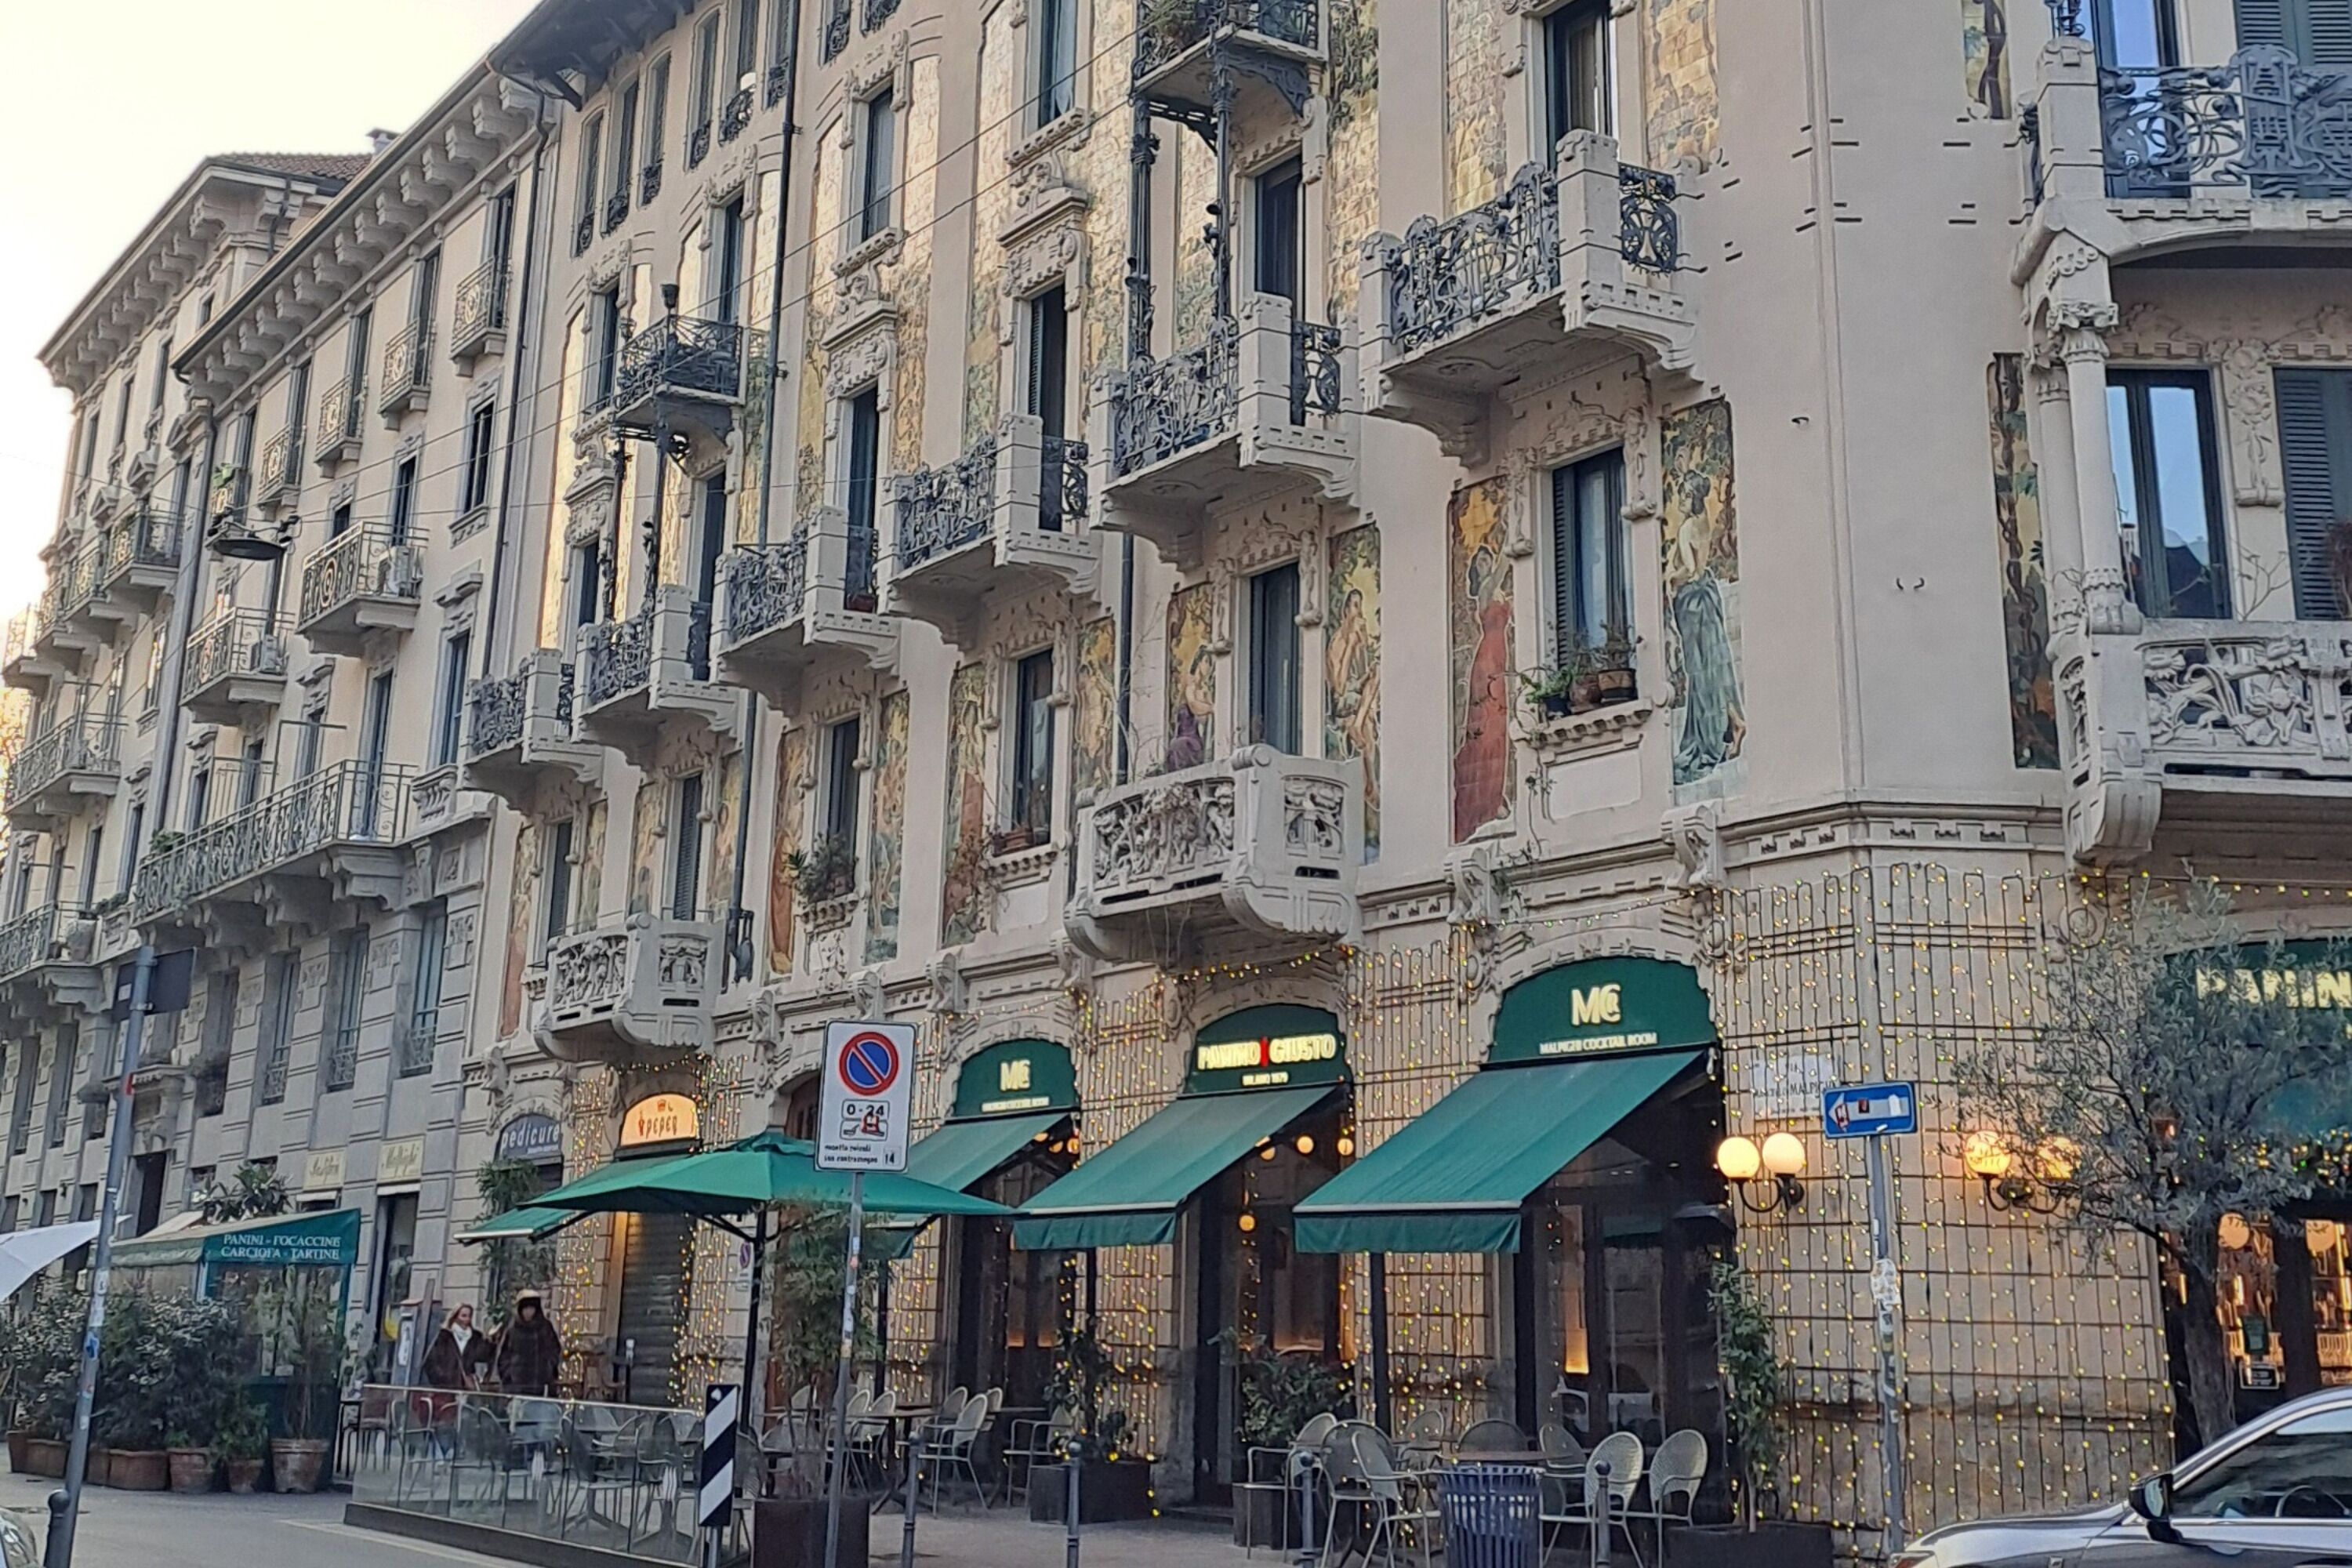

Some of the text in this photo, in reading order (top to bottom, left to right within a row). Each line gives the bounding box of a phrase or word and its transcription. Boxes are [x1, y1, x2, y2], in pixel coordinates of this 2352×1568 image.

[1269, 1033, 1337, 1064] GIUSTO
[1583, 1035, 1626, 1051] COCKTAIL
[1627, 1031, 1658, 1047] ROOM
[500, 1123, 560, 1155] pedicure
[223, 1234, 264, 1245] PANINI
[273, 1235, 340, 1247] FOCACCINE
[291, 1248, 339, 1260] TARTINE
